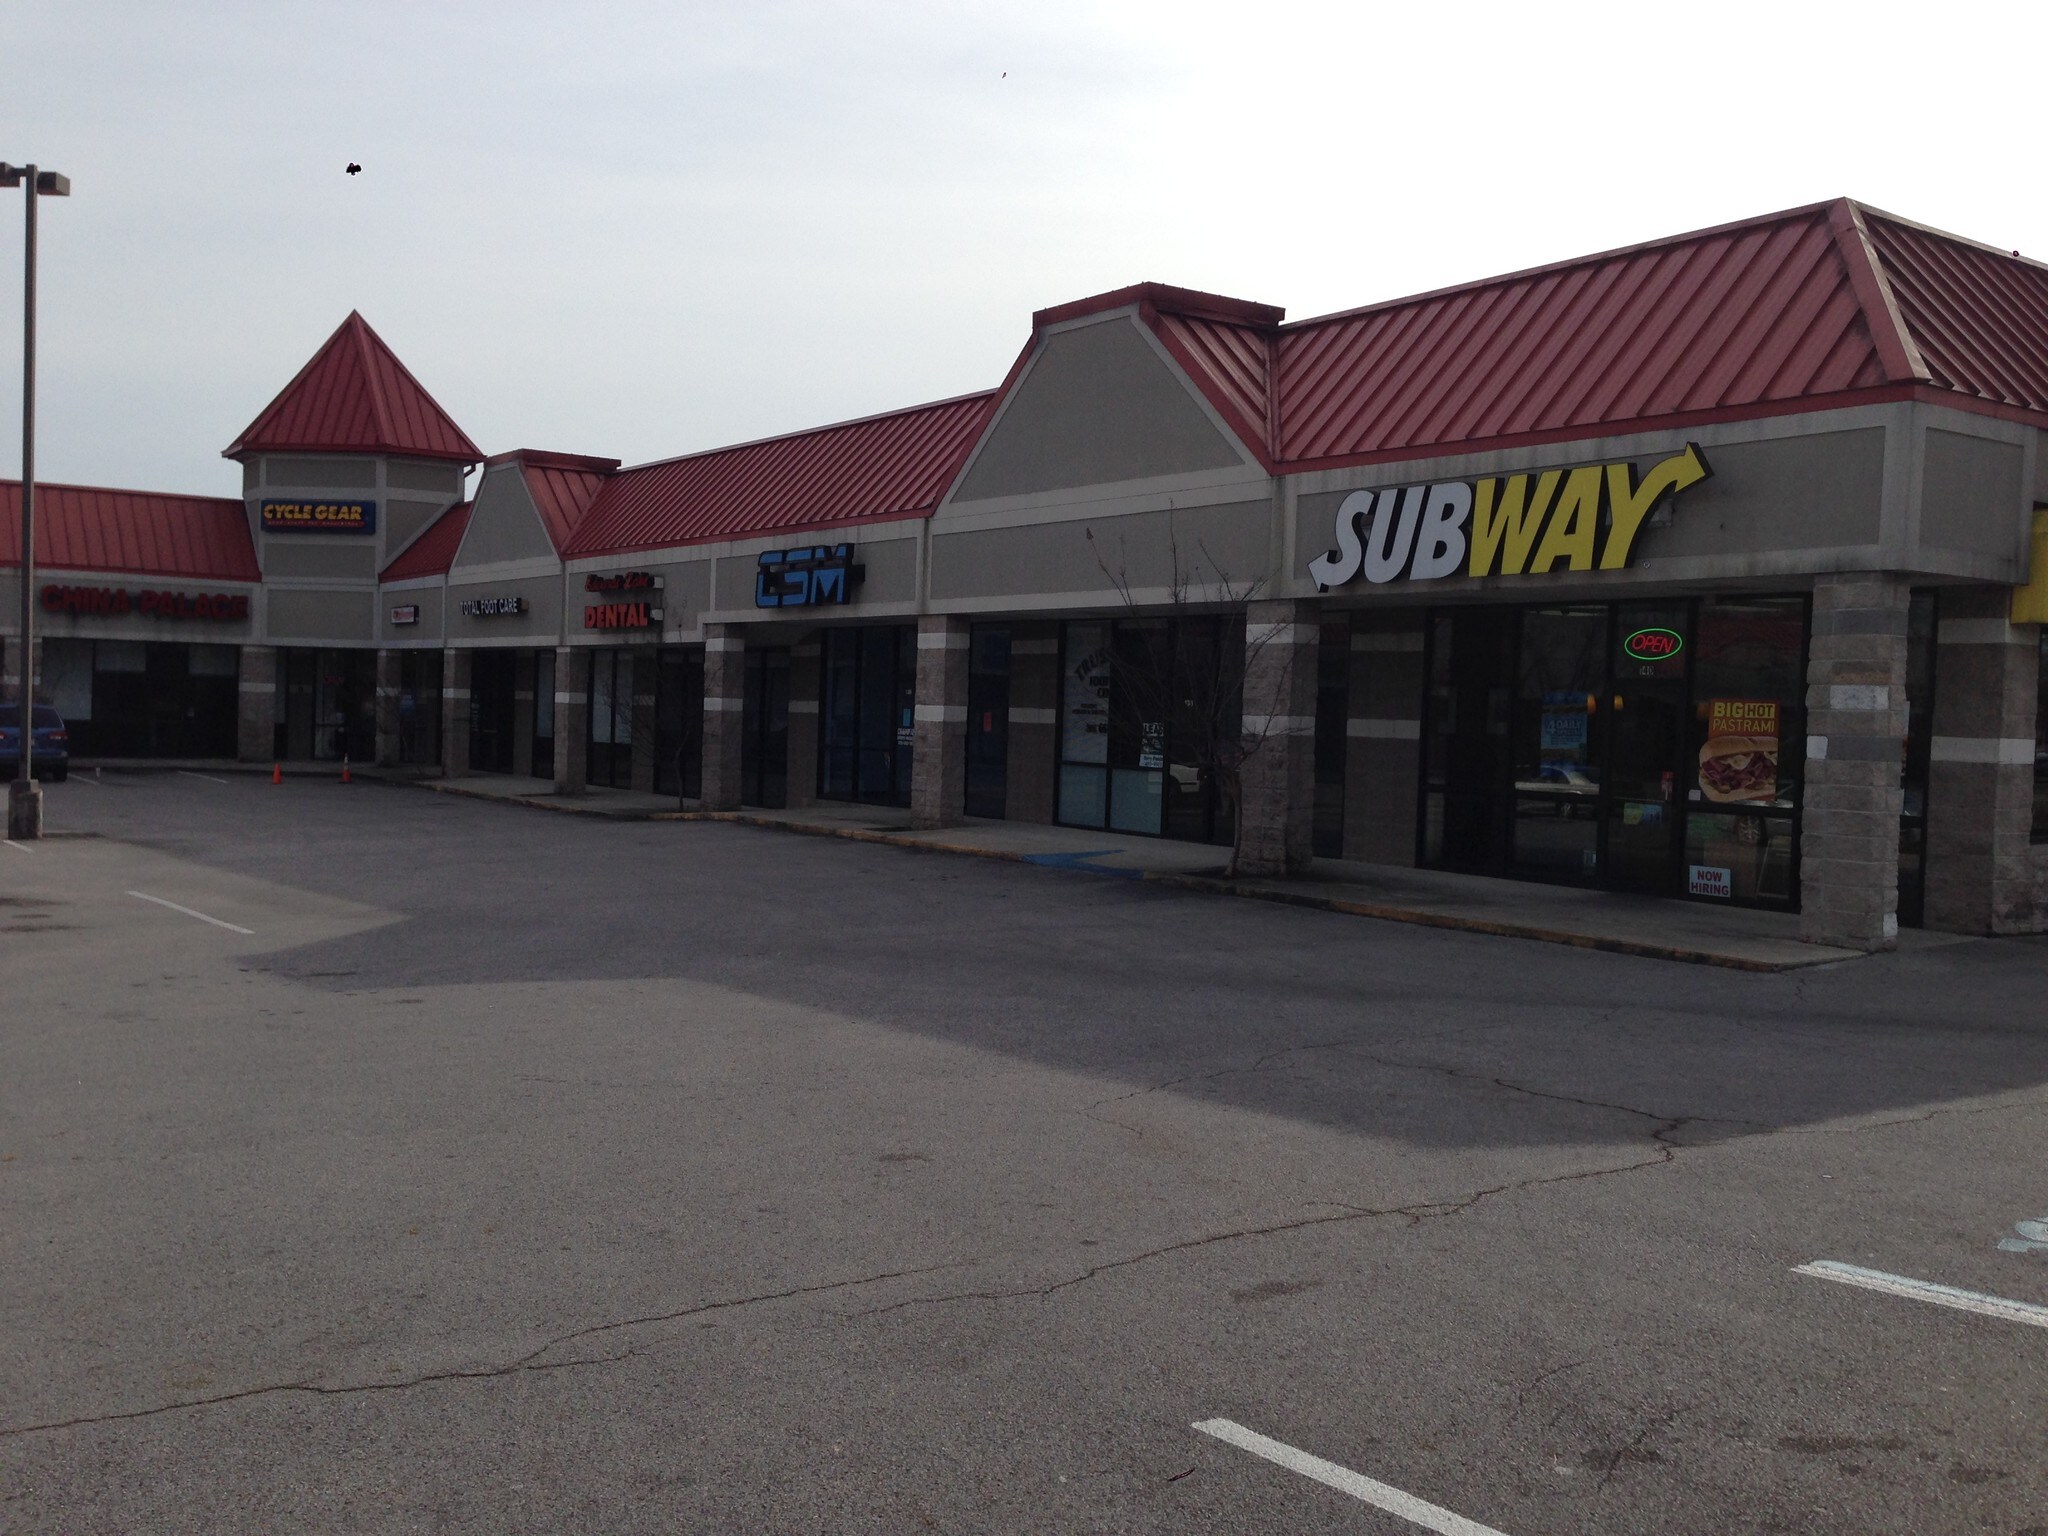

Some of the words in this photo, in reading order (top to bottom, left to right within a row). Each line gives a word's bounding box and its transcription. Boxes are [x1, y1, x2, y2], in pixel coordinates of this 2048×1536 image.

[263, 504, 313, 519] CYCLE
[314, 504, 363, 520] GEAR
[1307, 442, 1715, 593] SUBWAY
[41, 584, 131, 615] CHINA
[139, 590, 249, 621] PALACE
[459, 600, 480, 616] TOTAL
[480, 599, 500, 615] FOOT
[499, 597, 518, 614] CARE
[585, 602, 649, 628] DENTAL
[1631, 634, 1676, 654] OPEN
[1713, 702, 1745, 718] BIG
[1745, 703, 1775, 718] HOT
[1712, 718, 1775, 733] PASTRAMI
[1697, 870, 1723, 882] NOW
[1691, 882, 1730, 896] HIRING
